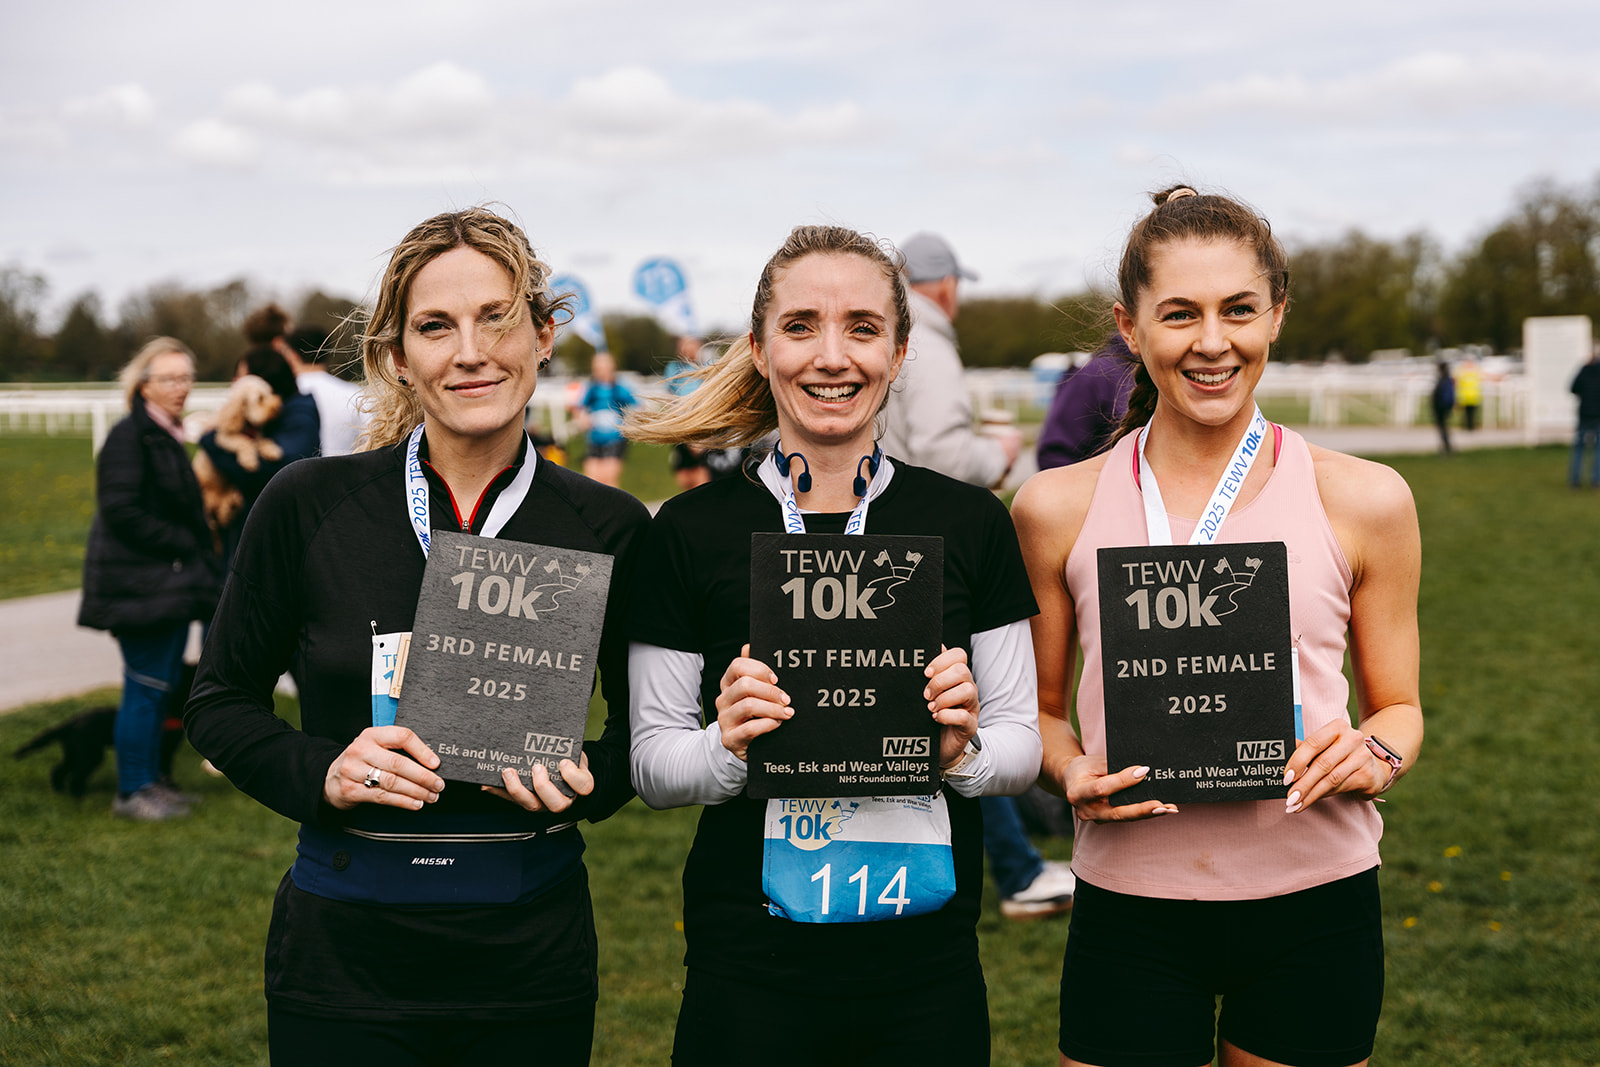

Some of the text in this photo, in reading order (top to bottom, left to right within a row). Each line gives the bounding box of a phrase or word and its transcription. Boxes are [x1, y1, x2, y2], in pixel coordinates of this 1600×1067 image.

[1200, 430, 1262, 541] 2025 TEWV 10k
[411, 487, 427, 527] 2025
[456, 545, 537, 576] TEWV
[780, 550, 866, 573] TEWV
[1122, 559, 1205, 586] TEWV
[450, 572, 543, 622] 10k
[780, 574, 878, 619] 10k
[1125, 583, 1222, 631] 10k
[426, 634, 583, 672] 3RD FEMALE
[773, 649, 925, 668] 1ST FEMALE
[1117, 652, 1276, 678] 2ND FEMALE
[467, 677, 528, 701] 2025
[817, 689, 877, 707] 2025
[1168, 694, 1227, 715] 2025
[527, 734, 572, 754] NHS
[885, 738, 928, 755] NHS
[1239, 742, 1283, 760] NHS
[438, 743, 459, 756] Esk
[462, 747, 487, 760] and
[490, 750, 523, 765] Wear
[526, 755, 561, 773] Valley
[476, 762, 495, 772] NHS
[764, 760, 929, 775] Tees, Esk and Wear Valleys
[839, 774, 930, 783] NHS Foundation Trust
[1155, 767, 1176, 780] Esk
[1178, 766, 1202, 779] and
[1205, 766, 1239, 777] Wear
[1241, 764, 1285, 777] Valleys
[1196, 778, 1283, 789] NHS Foundation Trus
[779, 799, 827, 813] TEWV
[779, 814, 832, 841] 10k
[811, 863, 911, 916] 114
